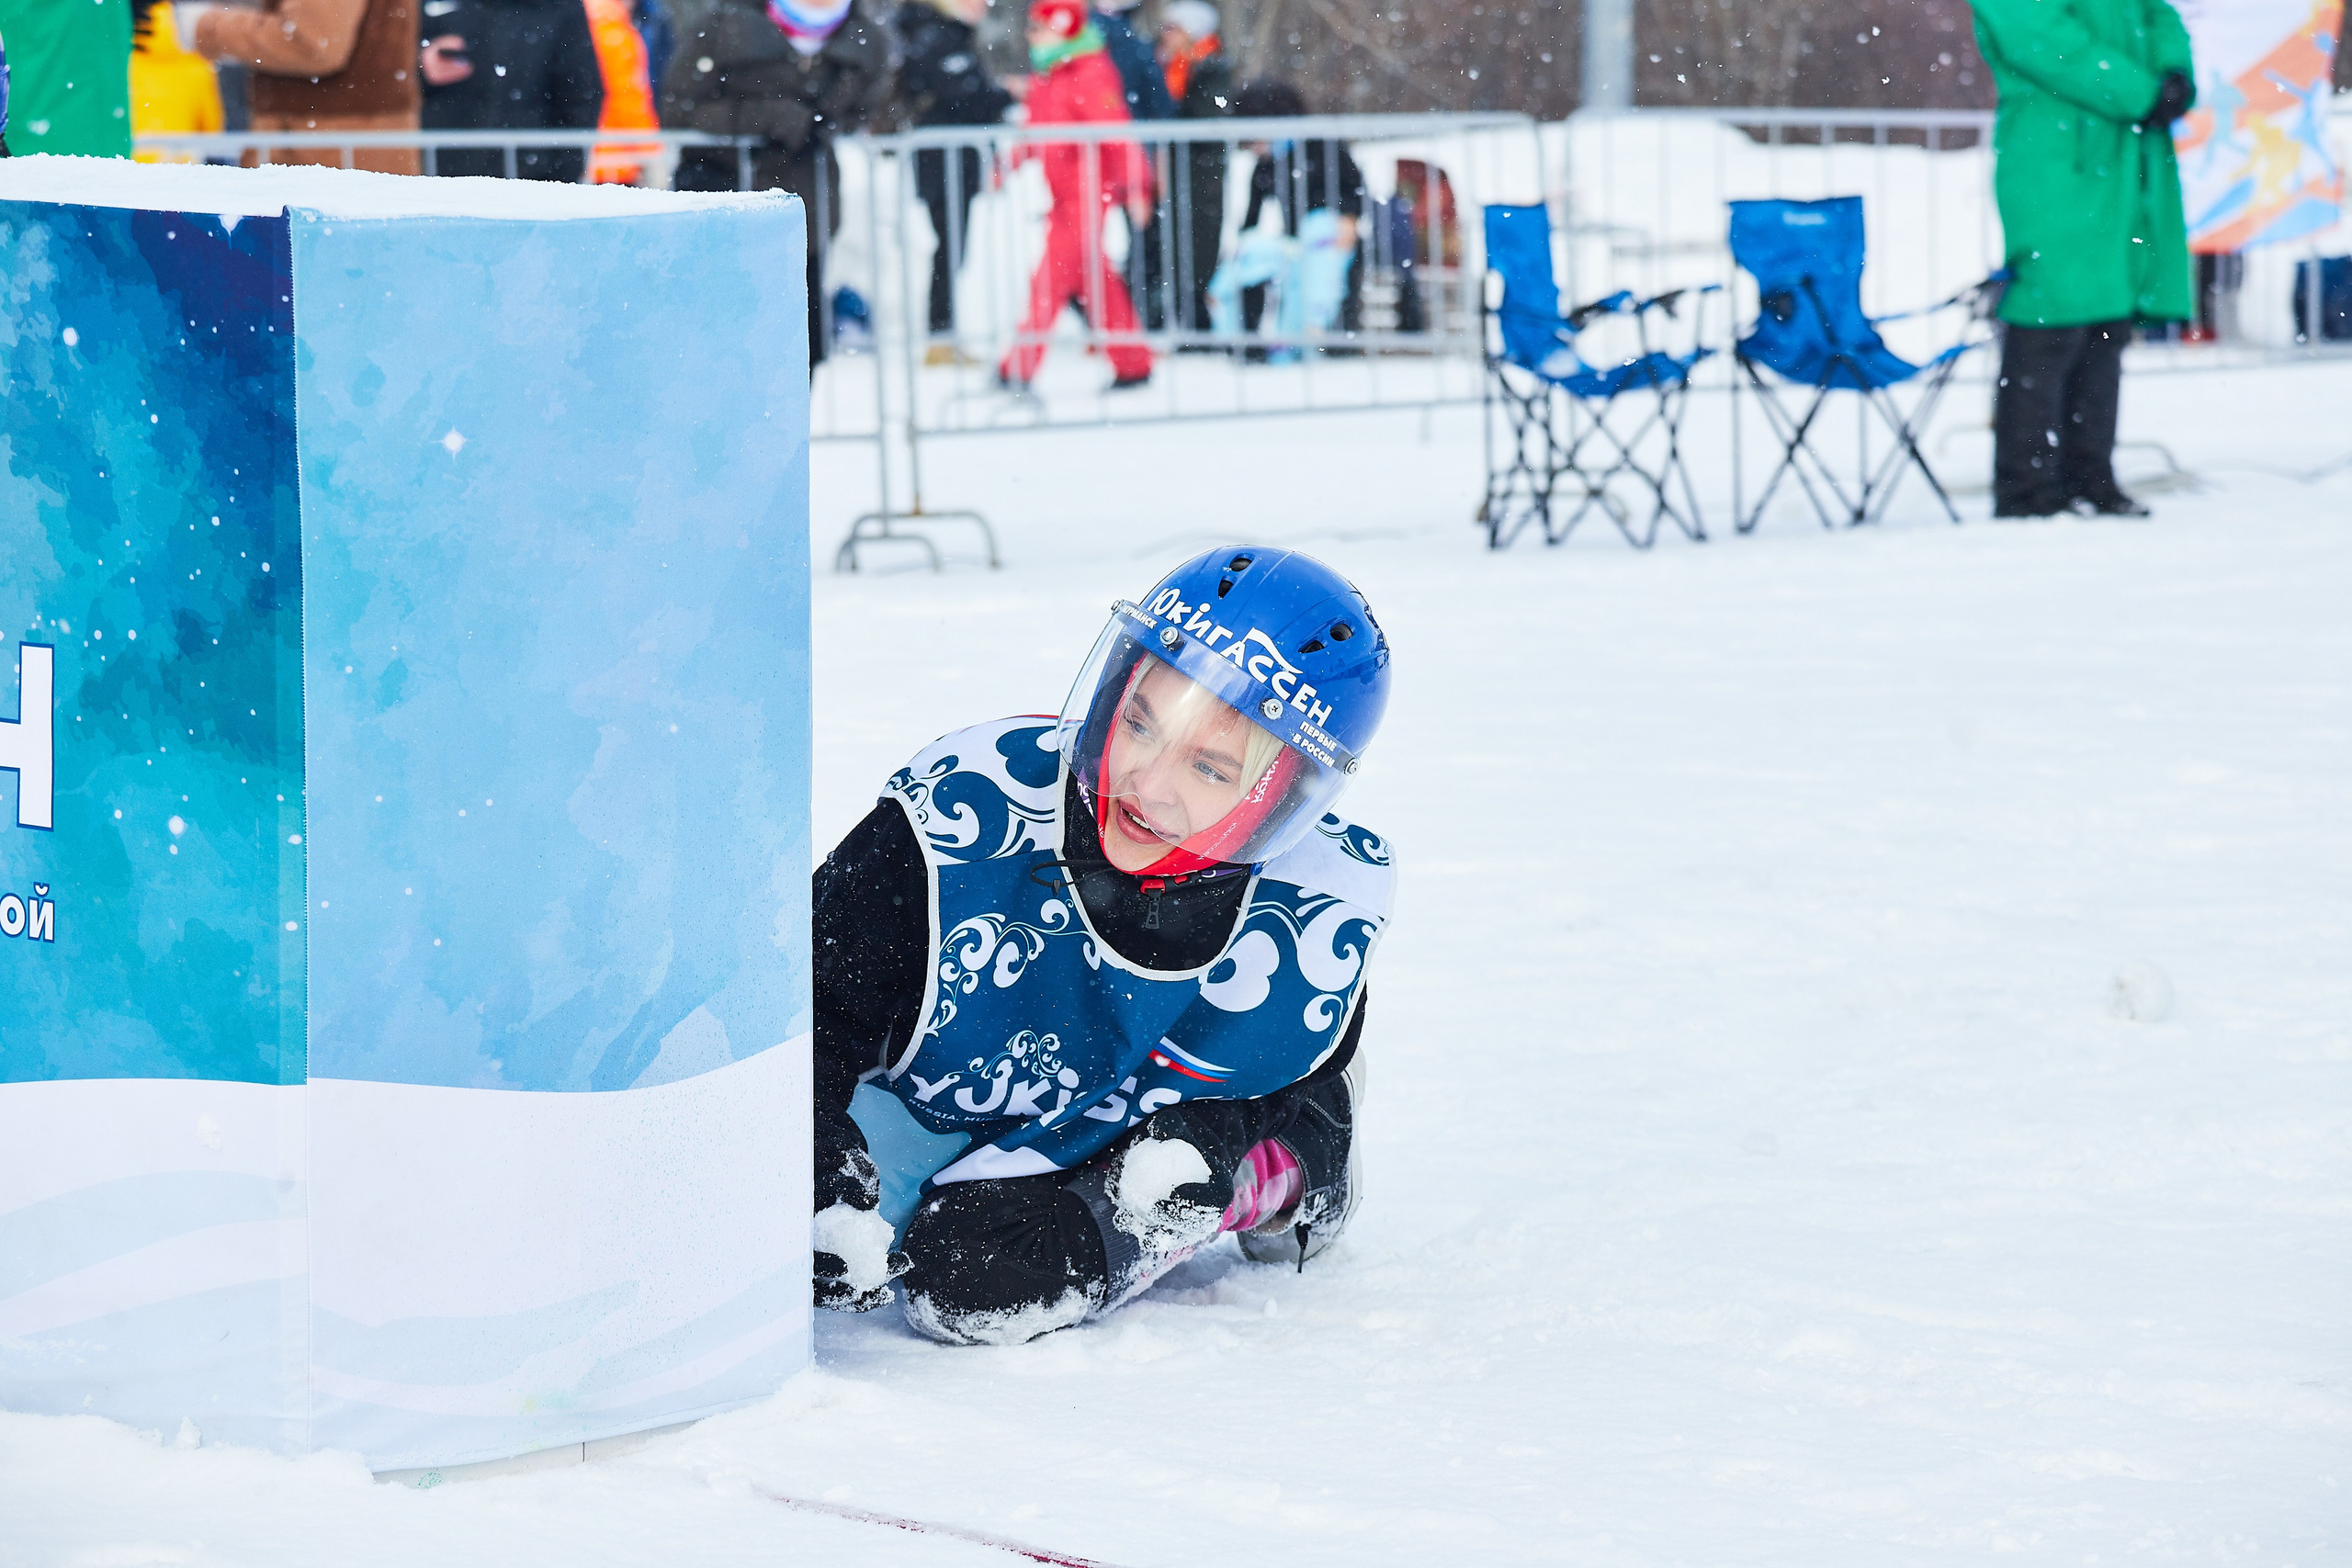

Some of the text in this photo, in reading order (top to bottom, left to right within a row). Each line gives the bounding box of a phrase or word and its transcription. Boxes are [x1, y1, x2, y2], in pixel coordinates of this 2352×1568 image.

[1292, 732, 1335, 768] В РОССИИ
[1299, 720, 1338, 752] ПЕРВЫЕ
